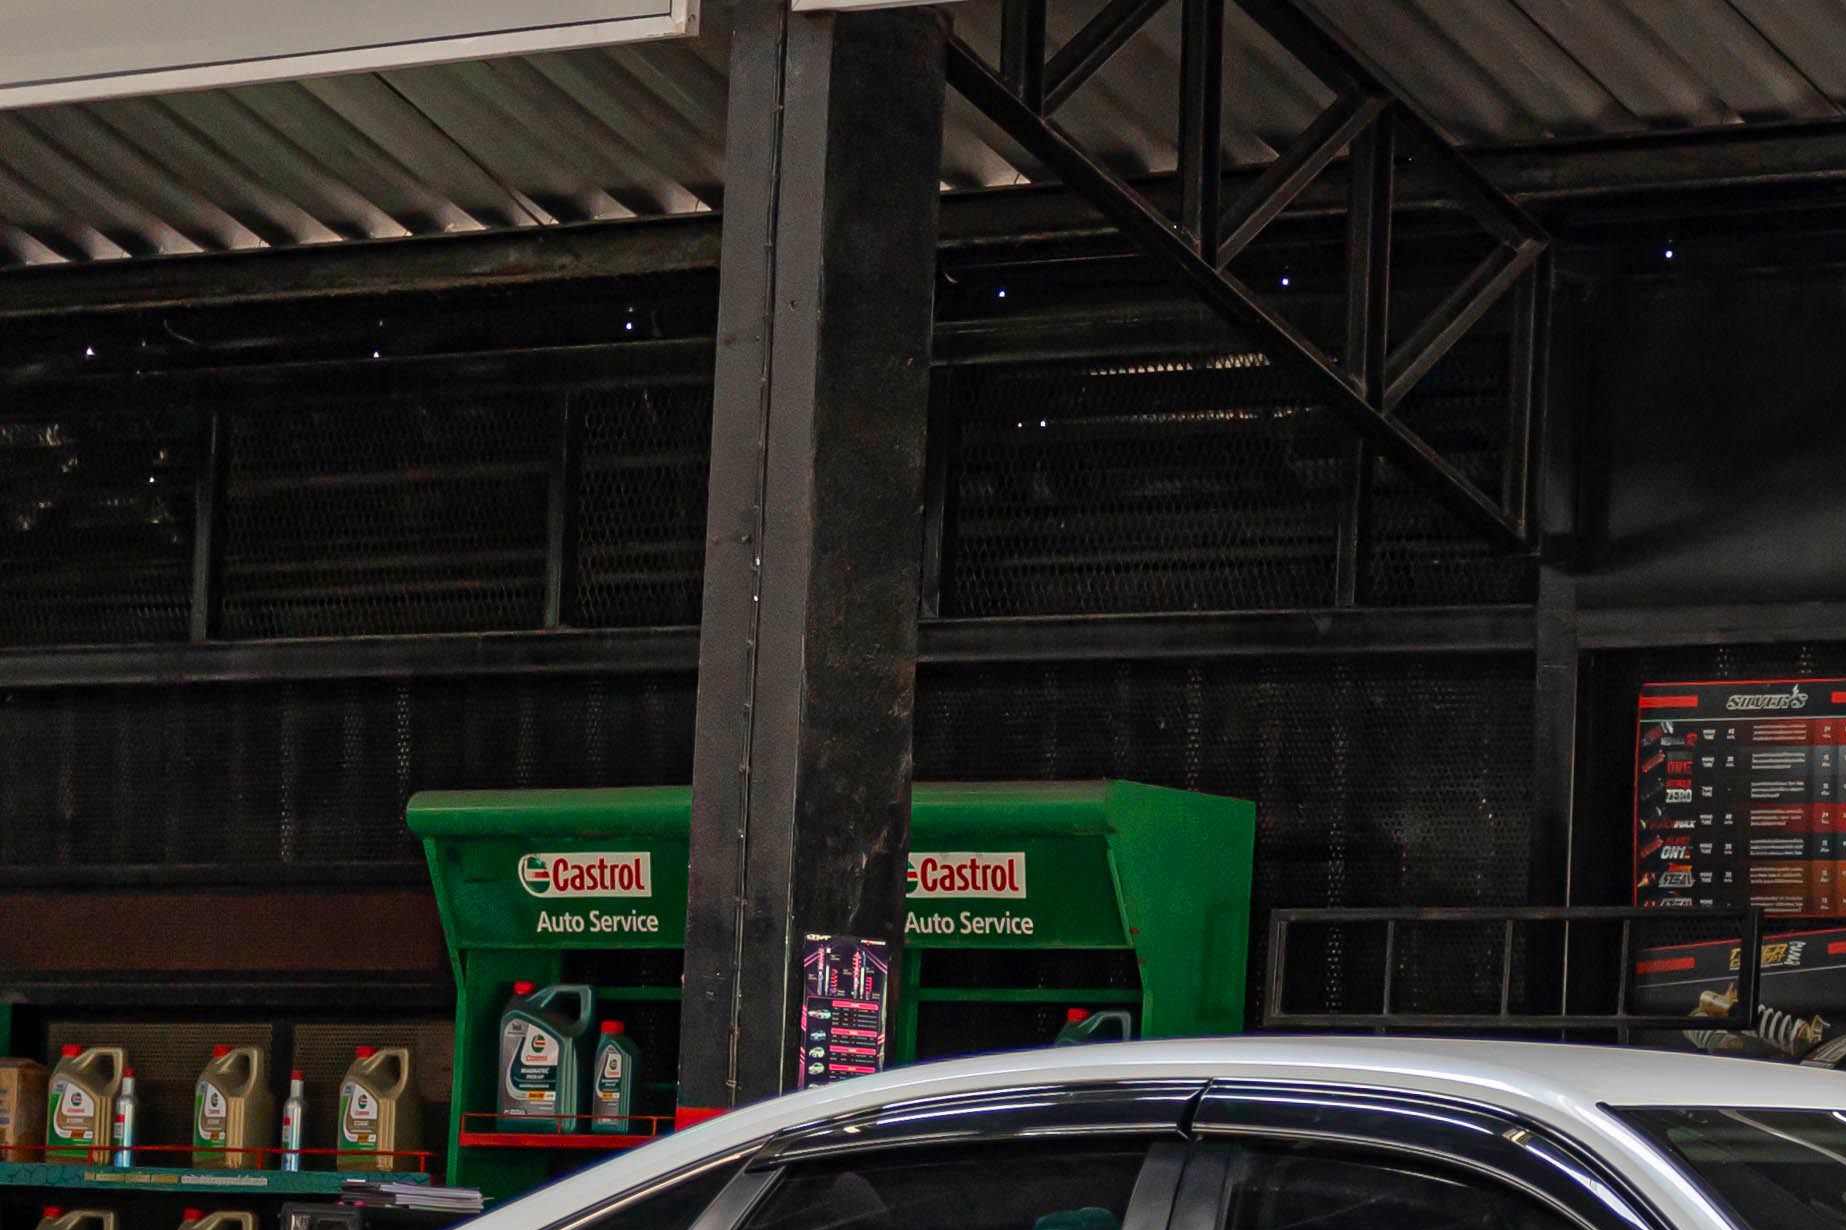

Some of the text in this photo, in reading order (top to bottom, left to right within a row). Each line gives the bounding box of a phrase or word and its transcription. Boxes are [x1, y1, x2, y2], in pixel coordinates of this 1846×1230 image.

[553, 858, 645, 891] Castrol
[920, 857, 1019, 892] Castrol
[536, 909, 659, 932] Auto Service
[904, 911, 1034, 934] Auto Service
